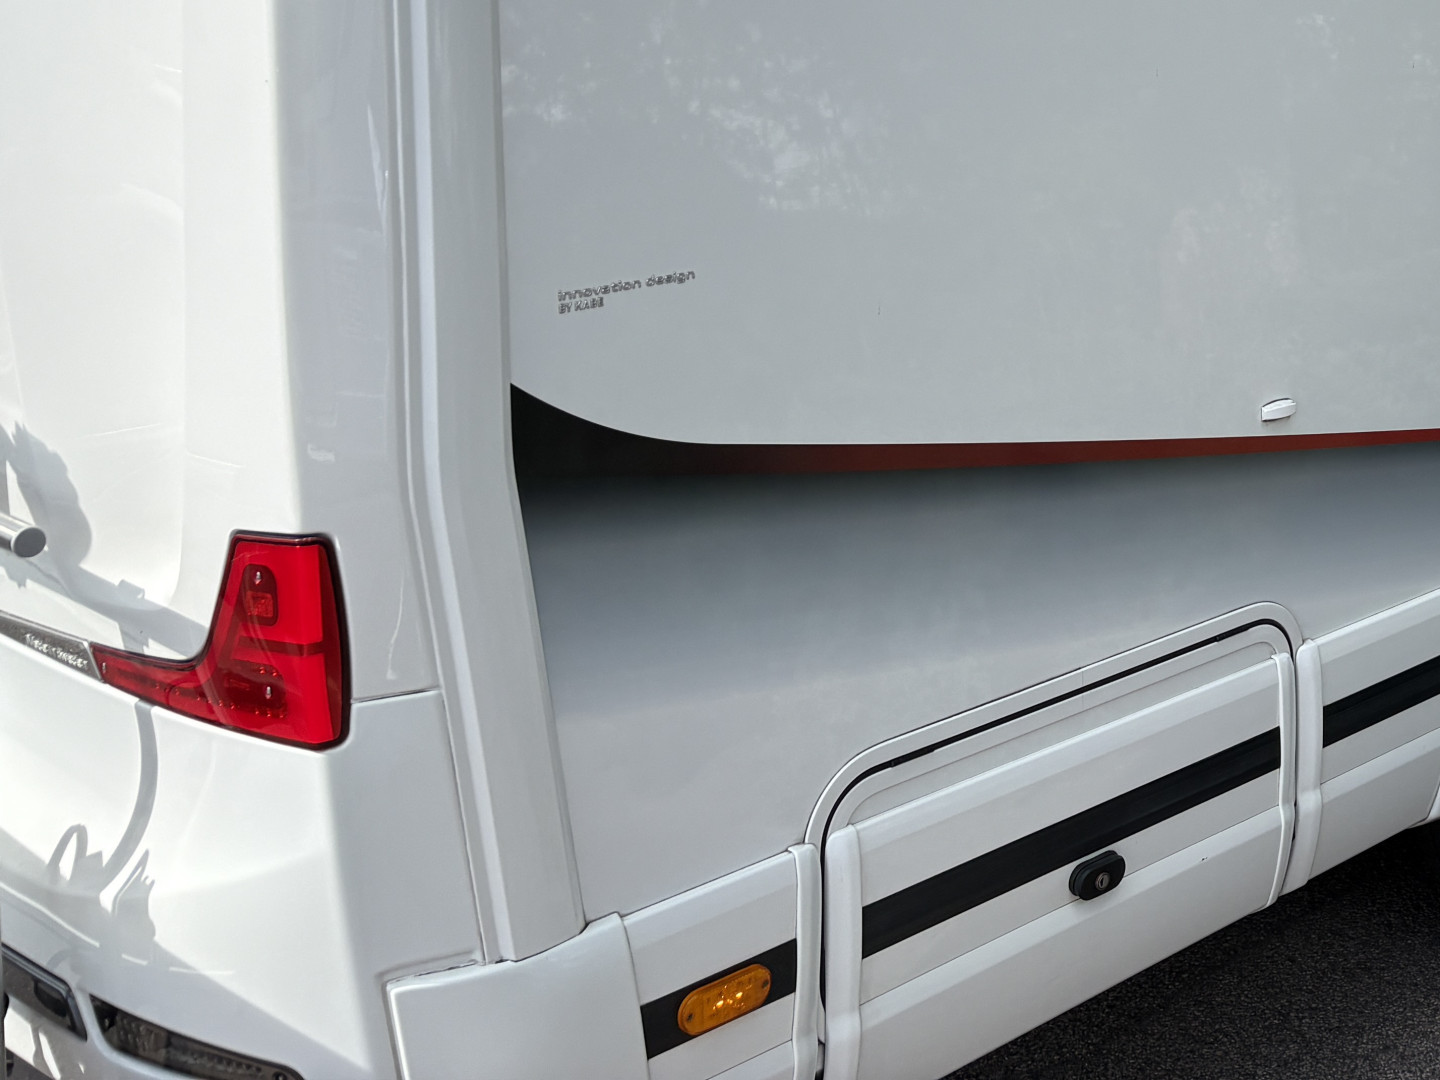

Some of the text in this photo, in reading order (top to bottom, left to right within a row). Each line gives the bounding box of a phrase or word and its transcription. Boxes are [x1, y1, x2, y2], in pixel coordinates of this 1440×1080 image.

[558, 270, 696, 302] innovation design
[558, 297, 605, 315] BY KABE
